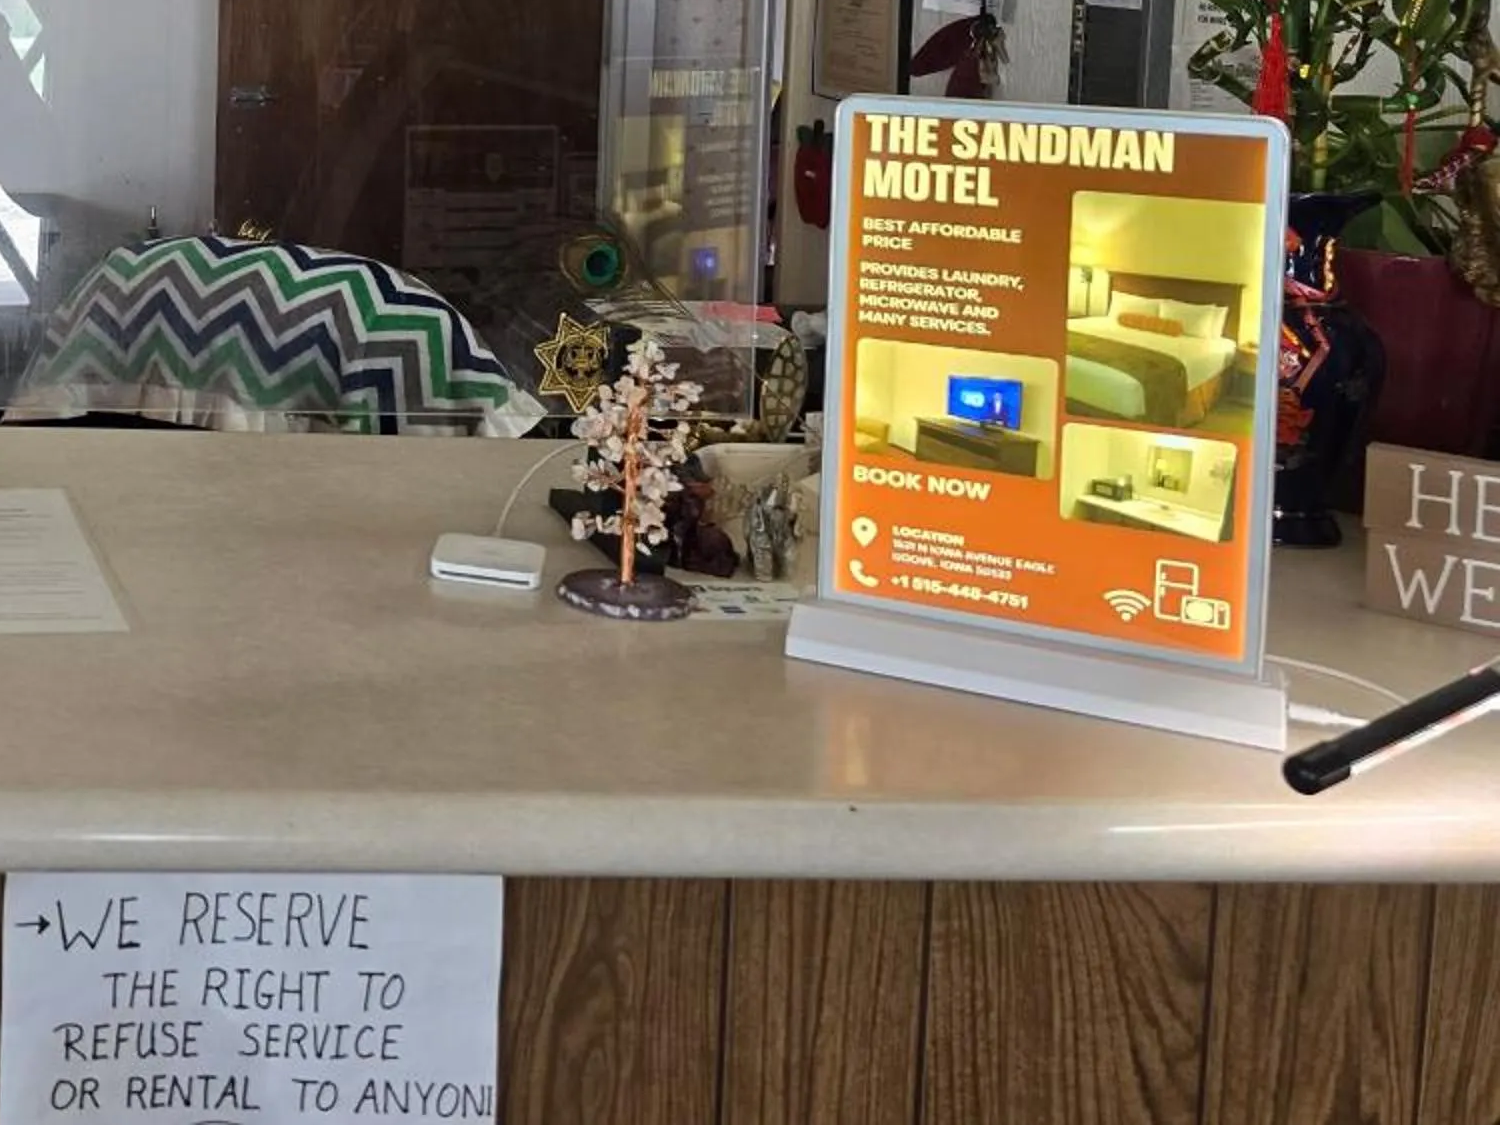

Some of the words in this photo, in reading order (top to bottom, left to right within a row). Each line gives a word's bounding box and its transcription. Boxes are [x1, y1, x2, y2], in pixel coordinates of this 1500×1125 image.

[865, 114, 939, 157] THE
[951, 120, 1175, 173] SANDMAN
[863, 159, 999, 208] MOTEL
[862, 234, 913, 251] PRICE
[863, 217, 906, 235] BEST
[909, 220, 1022, 244] AFFORDABLE
[860, 261, 939, 280] PROVIDES
[942, 267, 1025, 292] LAUNDRY,
[858, 310, 907, 327] MANY
[910, 315, 991, 336] SERVICES.
[859, 295, 959, 317] MICROWAVE
[962, 304, 1000, 320] AND
[853, 465, 922, 492] BOOK
[927, 474, 991, 501] NOW
[1404, 463, 1500, 543] HE
[892, 526, 965, 547] LOCATION
[965, 550, 1012, 567] AVENUE
[1384, 543, 1500, 628] WE
[57, 896, 142, 952] WE
[178, 892, 371, 949] RESERVE
[102, 969, 179, 1008] THE
[202, 967, 331, 1011] RIGHT
[358, 971, 405, 1012] TO
[53, 1021, 202, 1061] REFUSE
[238, 1023, 404, 1062] SERVICE
[51, 1078, 101, 1112] OR
[125, 1075, 261, 1111] RENTAL
[291, 1078, 338, 1114] TO
[353, 1079, 494, 1118] ANYON
